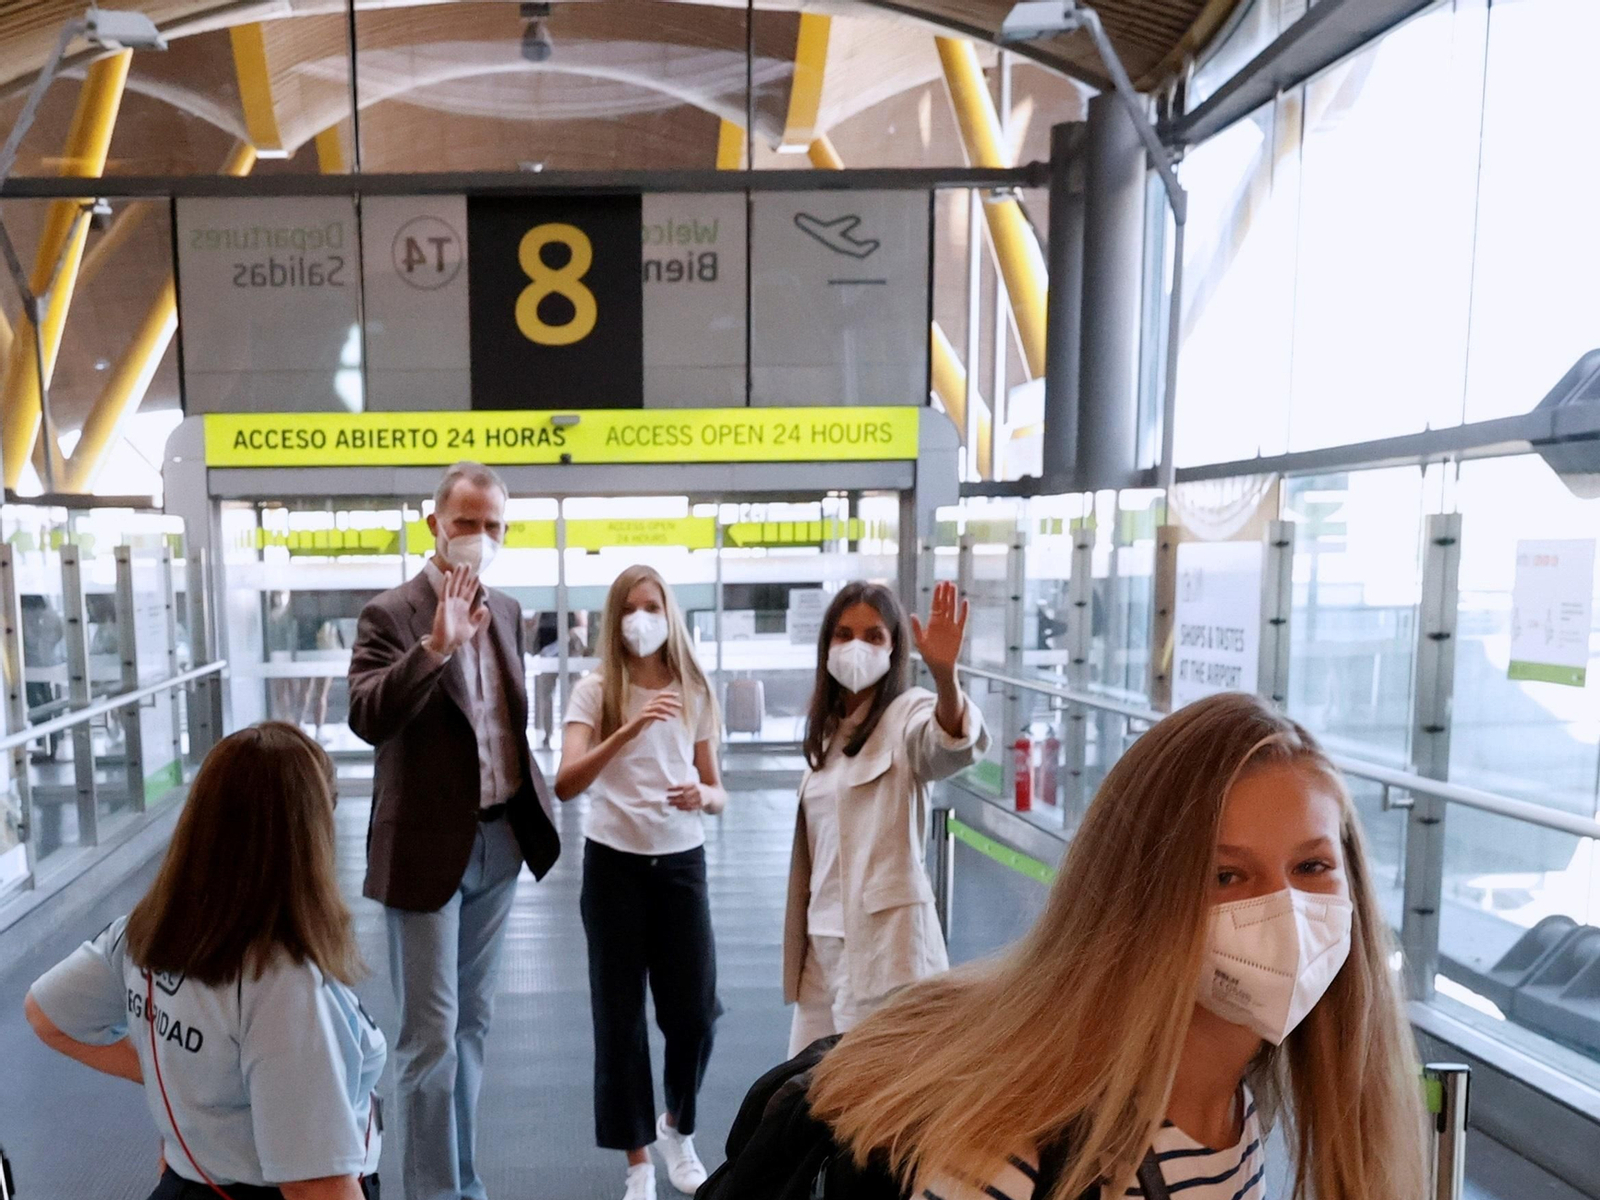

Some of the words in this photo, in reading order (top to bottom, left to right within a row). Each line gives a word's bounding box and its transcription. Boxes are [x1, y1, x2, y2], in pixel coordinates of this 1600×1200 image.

[515, 222, 598, 346] 8
[233, 429, 326, 450] ACCESO
[336, 428, 438, 449] ABIERTO
[448, 428, 475, 448] 24
[486, 427, 566, 448] HORAS
[605, 425, 693, 446] ACCESS
[701, 424, 764, 446] OPEN
[773, 424, 800, 445] 24
[812, 422, 892, 444] HOURS
